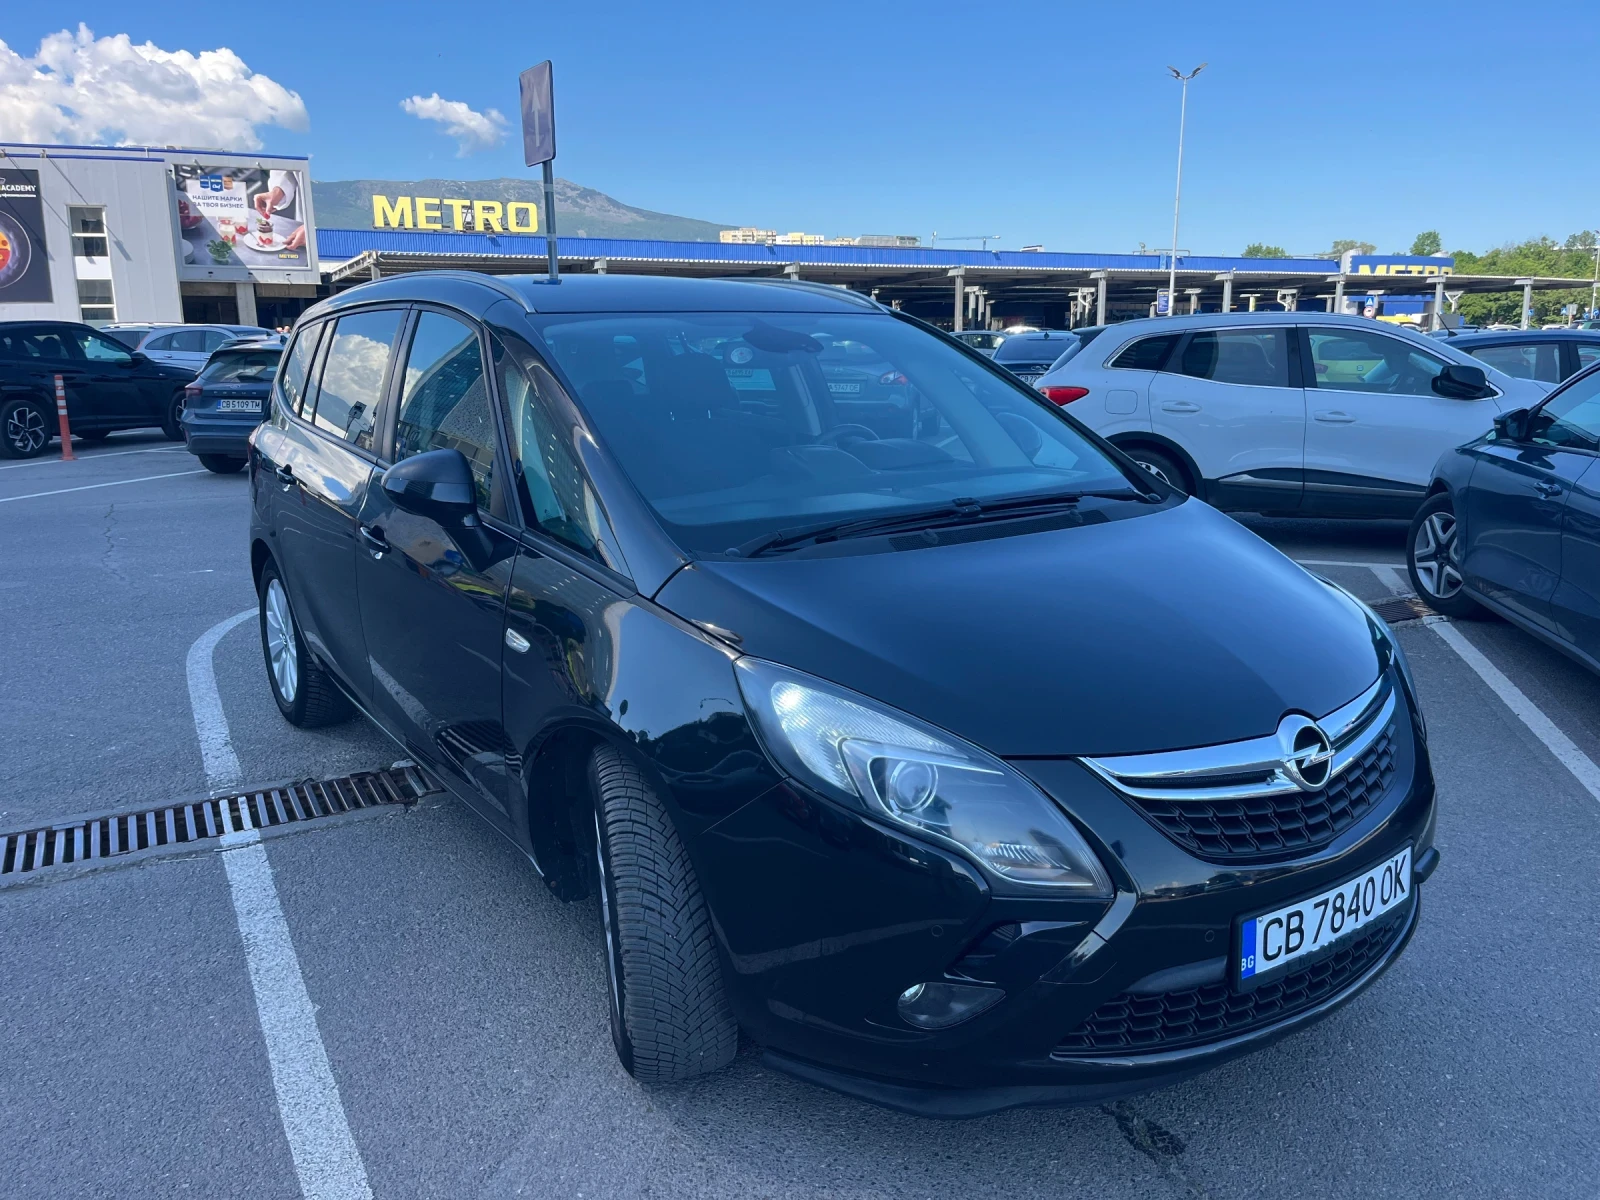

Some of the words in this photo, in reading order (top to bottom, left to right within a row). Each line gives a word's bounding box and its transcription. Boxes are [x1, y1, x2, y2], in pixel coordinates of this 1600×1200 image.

[1, 184, 36, 192] ACADEMY
[372, 195, 538, 233] METRO
[222, 400, 231, 408] CB
[231, 400, 249, 408] 5109
[1262, 909, 1304, 961] CB
[1312, 876, 1376, 945] 7840
[1380, 854, 1407, 906] OK
[1241, 955, 1254, 971] BG
